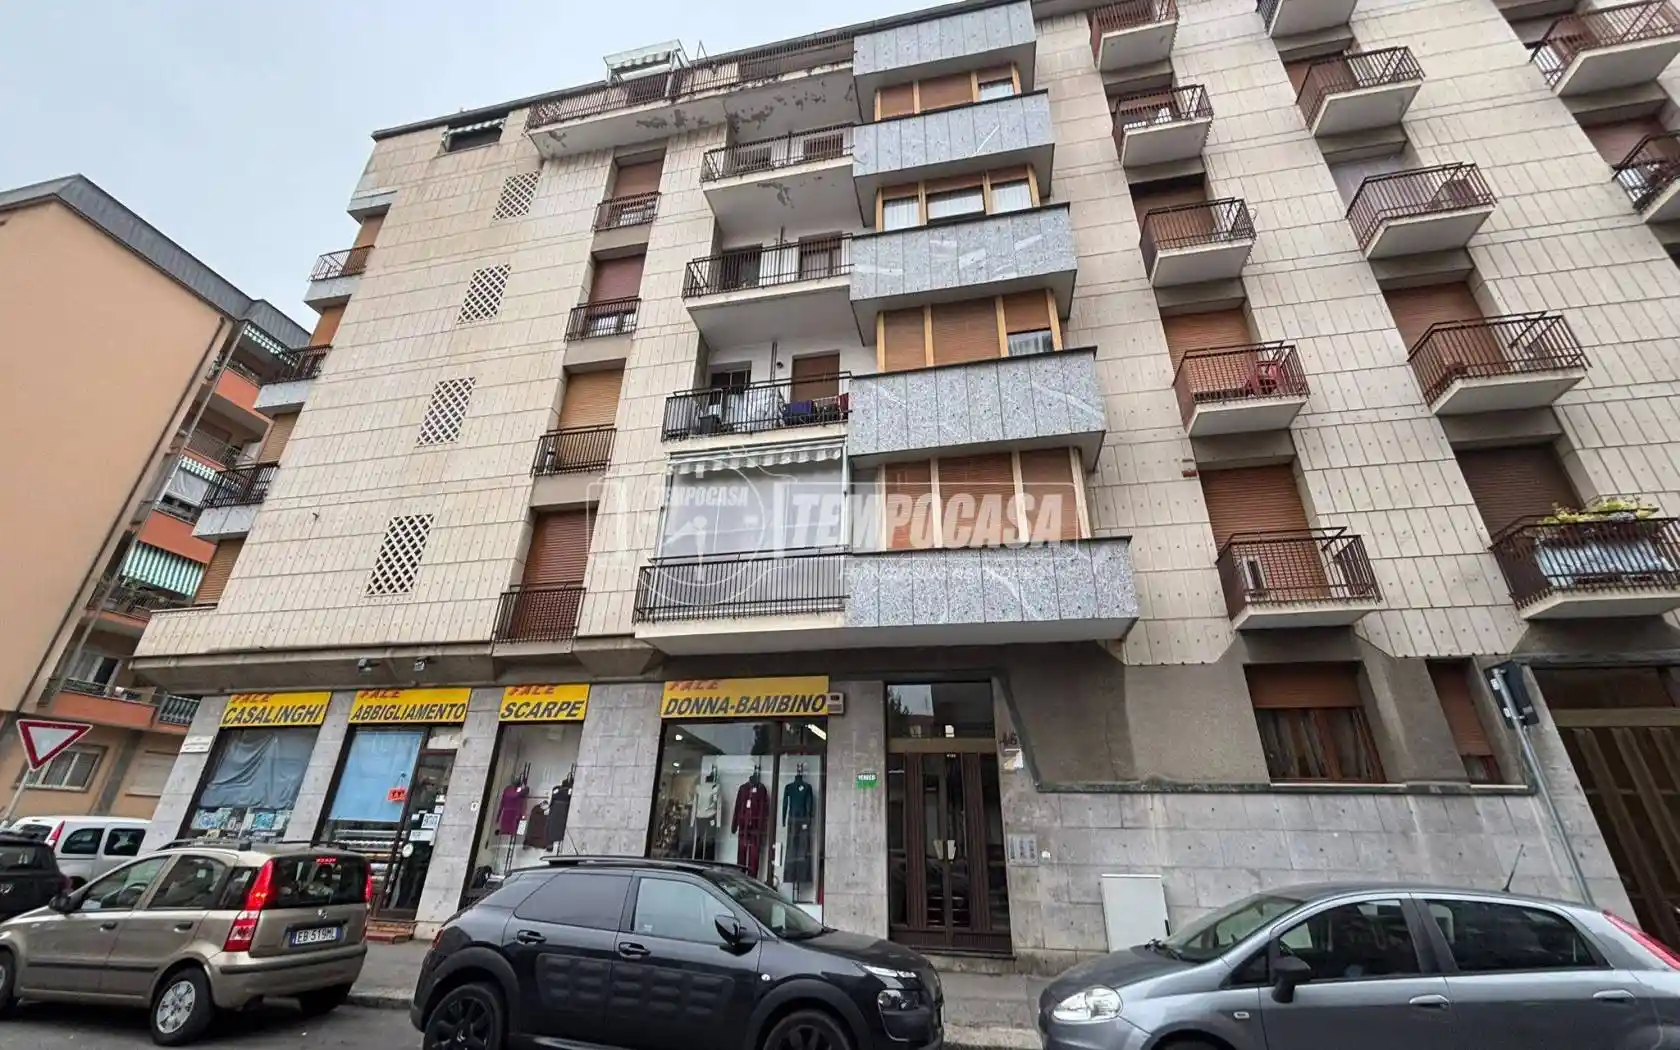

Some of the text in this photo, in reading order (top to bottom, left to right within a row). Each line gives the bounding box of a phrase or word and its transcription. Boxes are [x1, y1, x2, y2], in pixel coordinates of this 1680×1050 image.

[221, 704, 324, 725] CASALINGHI
[350, 703, 467, 721] ABBIGLIAMENTO
[500, 700, 585, 719] SCARPE
[663, 693, 828, 716] DONNA-BAMBINO
